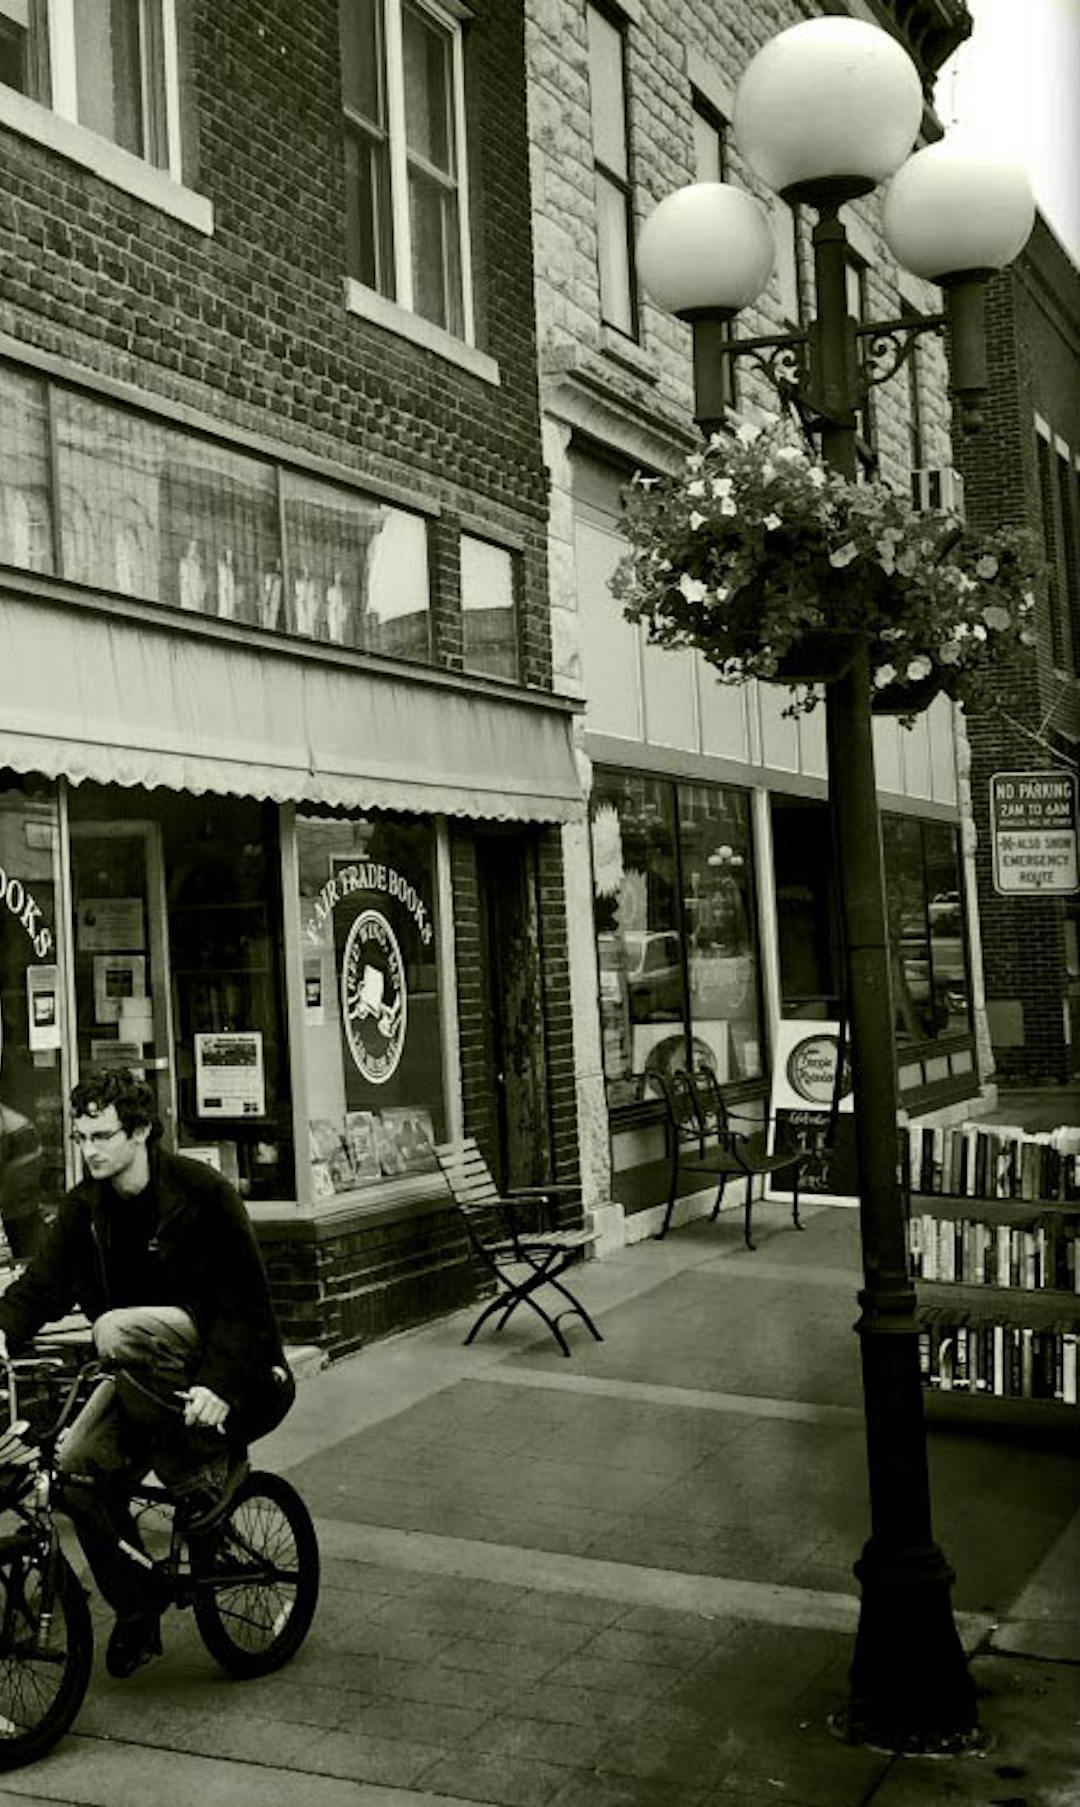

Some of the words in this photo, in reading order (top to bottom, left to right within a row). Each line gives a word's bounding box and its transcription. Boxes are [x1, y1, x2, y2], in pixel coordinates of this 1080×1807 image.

[996, 783, 1015, 799] NO
[1020, 782, 1072, 799] PARKING
[1028, 804, 1042, 816] TO
[1002, 854, 1070, 868] EMERGENCY
[1020, 871, 1055, 884] ROUTE
[339, 863, 387, 896] TRADE
[388, 867, 433, 944] BOOKS
